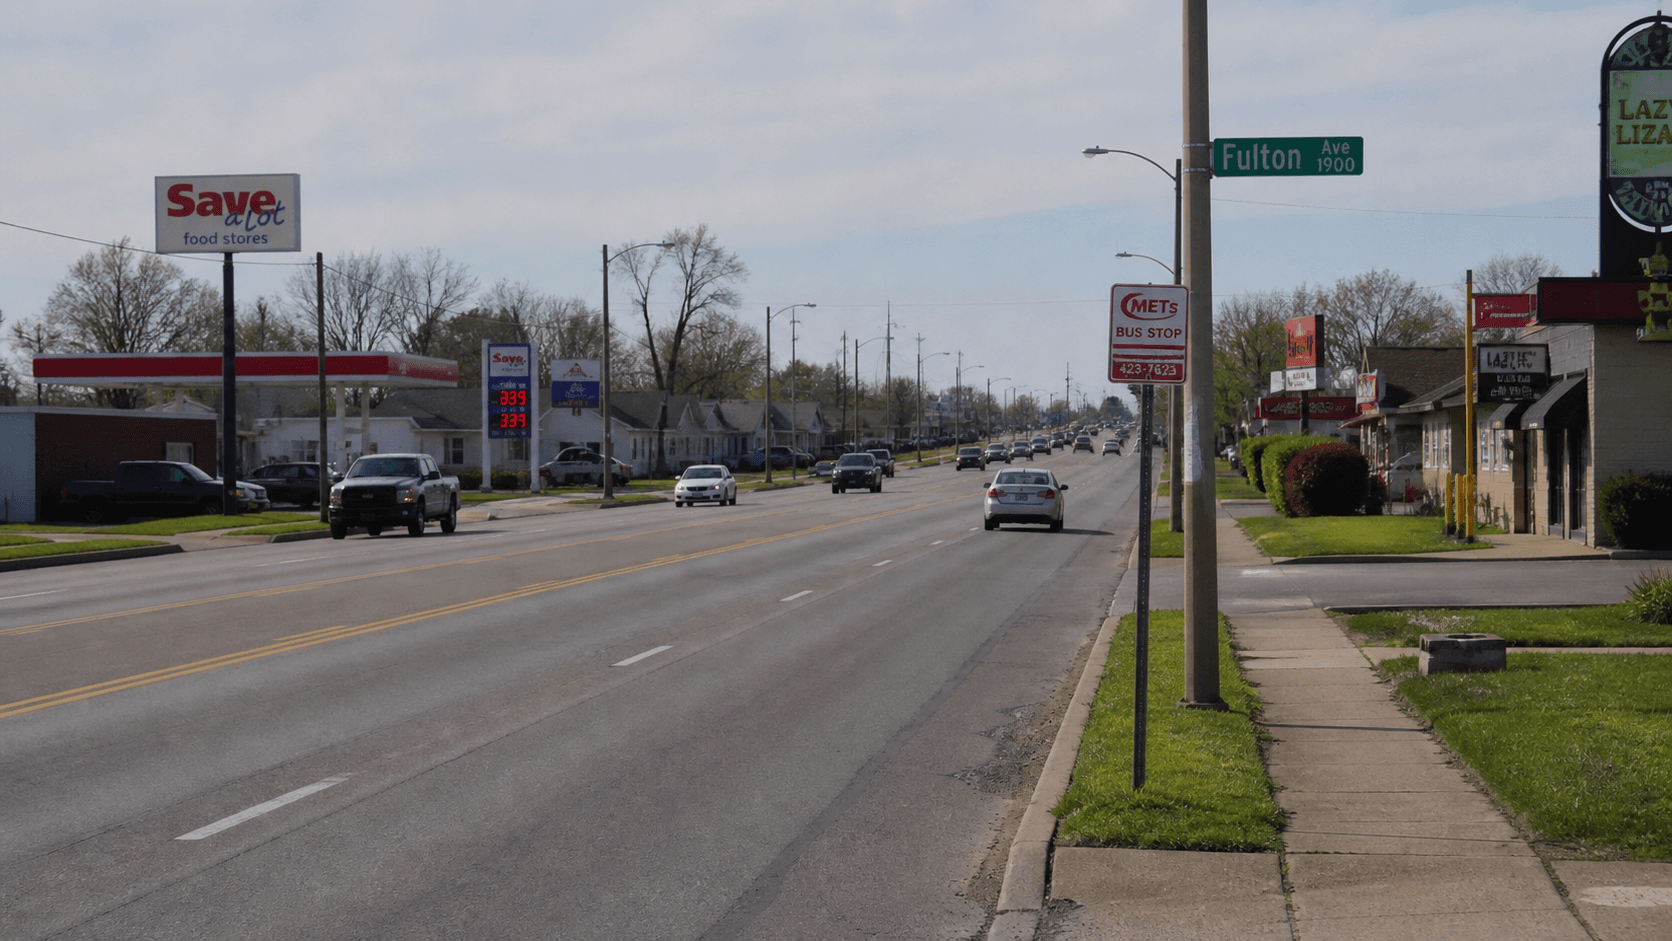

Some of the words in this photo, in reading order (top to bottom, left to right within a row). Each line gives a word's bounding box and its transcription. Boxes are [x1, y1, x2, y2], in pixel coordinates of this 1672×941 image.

[1223, 143, 1301, 171] Fulton
[1321, 139, 1350, 155] Ave
[1317, 157, 1355, 172] 1900
[167, 183, 277, 217] Save
[183, 232, 218, 245] food
[222, 232, 268, 245] stores
[1116, 326, 1142, 338] BUS
[1147, 327, 1182, 339] STOP
[493, 352, 524, 363] Save
